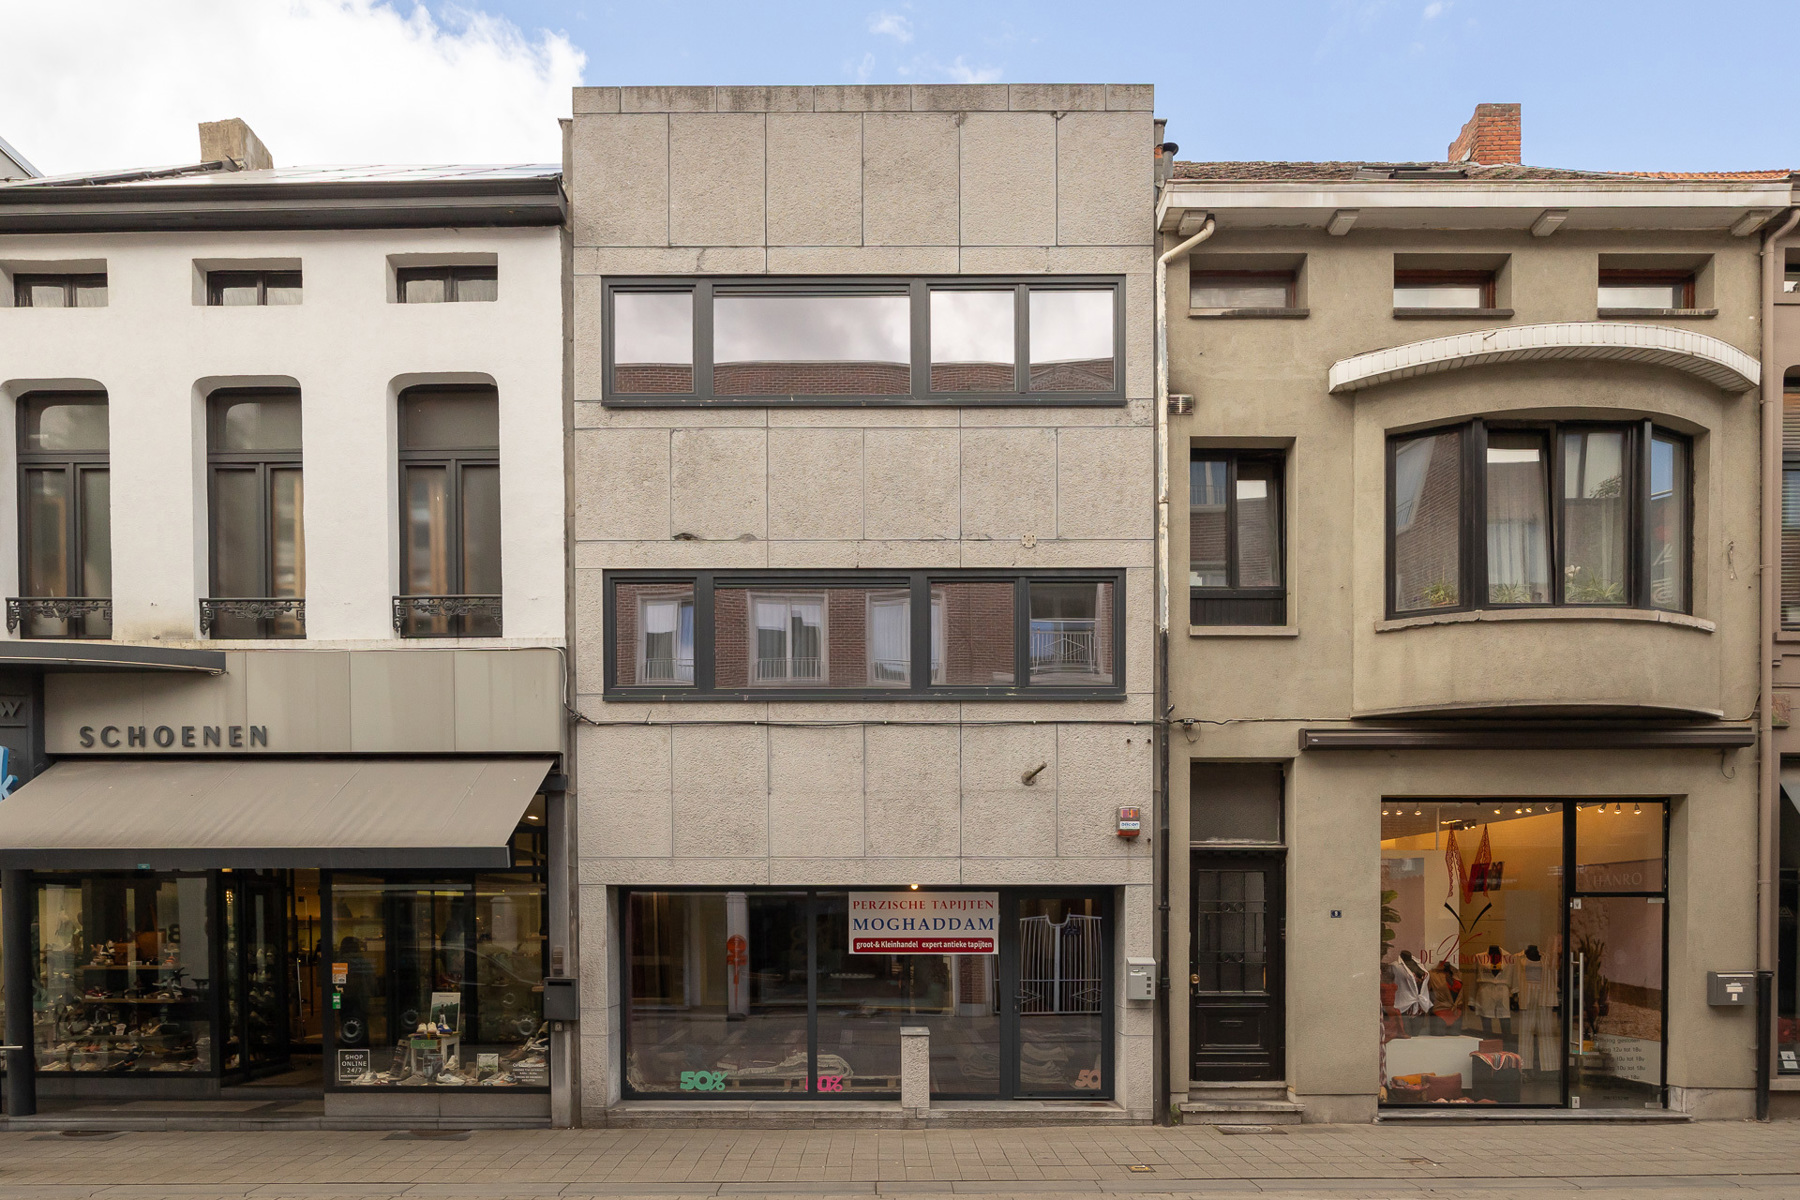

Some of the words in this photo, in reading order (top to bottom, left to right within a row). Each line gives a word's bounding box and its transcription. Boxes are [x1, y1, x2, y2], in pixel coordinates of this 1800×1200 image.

[79, 725, 268, 748] SCHOENEN
[1593, 871, 1643, 887] HANRO
[853, 900, 926, 910] PERZISCHE
[931, 900, 994, 911] TAPIJTEN
[852, 917, 995, 931] MOGHADDAM
[880, 940, 919, 948] Kleinhandel
[921, 942, 943, 950] expert
[967, 941, 993, 950] tapijten
[1420, 949, 1435, 965] DE
[680, 1070, 728, 1091] 50%
